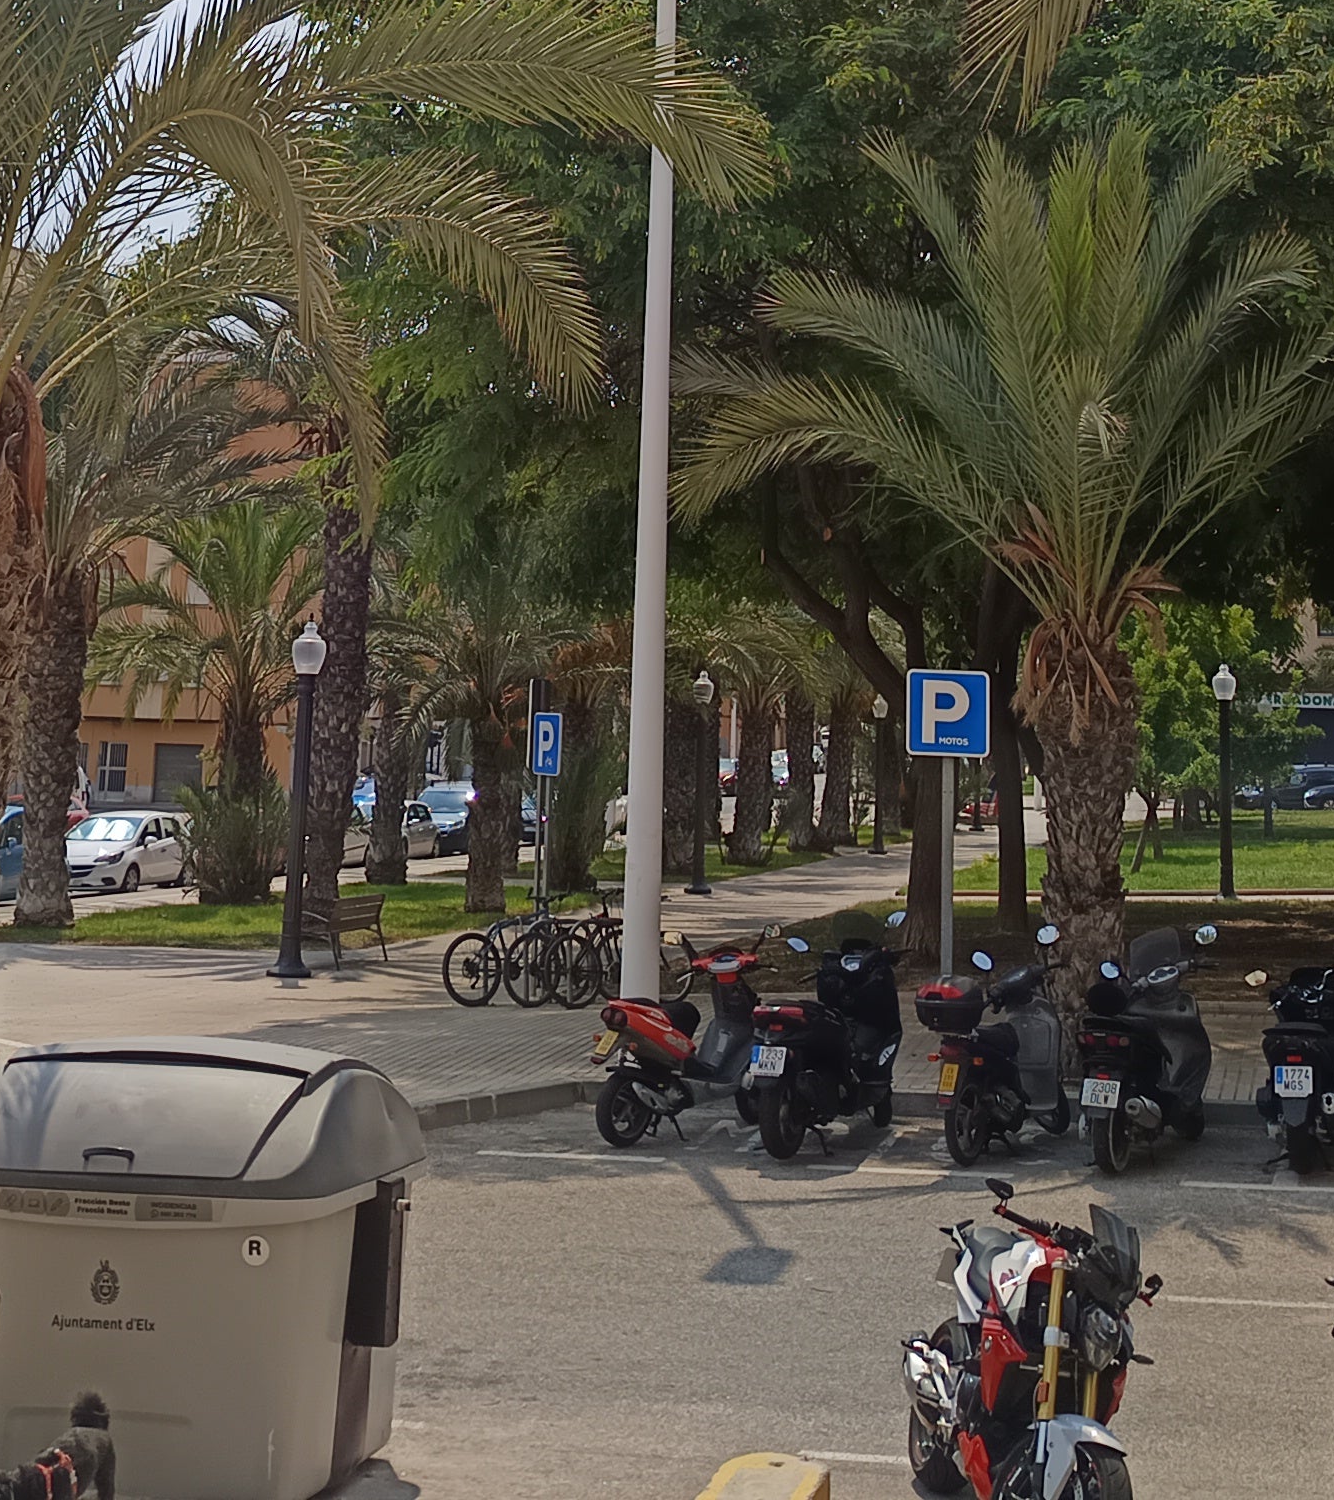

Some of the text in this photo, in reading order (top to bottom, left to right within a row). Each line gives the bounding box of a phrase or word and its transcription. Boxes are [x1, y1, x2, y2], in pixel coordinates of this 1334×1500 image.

[921, 678, 970, 744] P
[537, 720, 555, 768] P
[938, 736, 970, 747] MOTOS
[760, 1048, 785, 1061] 1233
[1284, 1068, 1310, 1080] 1774
[1092, 1081, 1118, 1095] 2308
[1283, 1080, 1304, 1091] MGS
[248, 1239, 262, 1257] R
[51, 1314, 156, 1332] Ajuntament d'Elx
